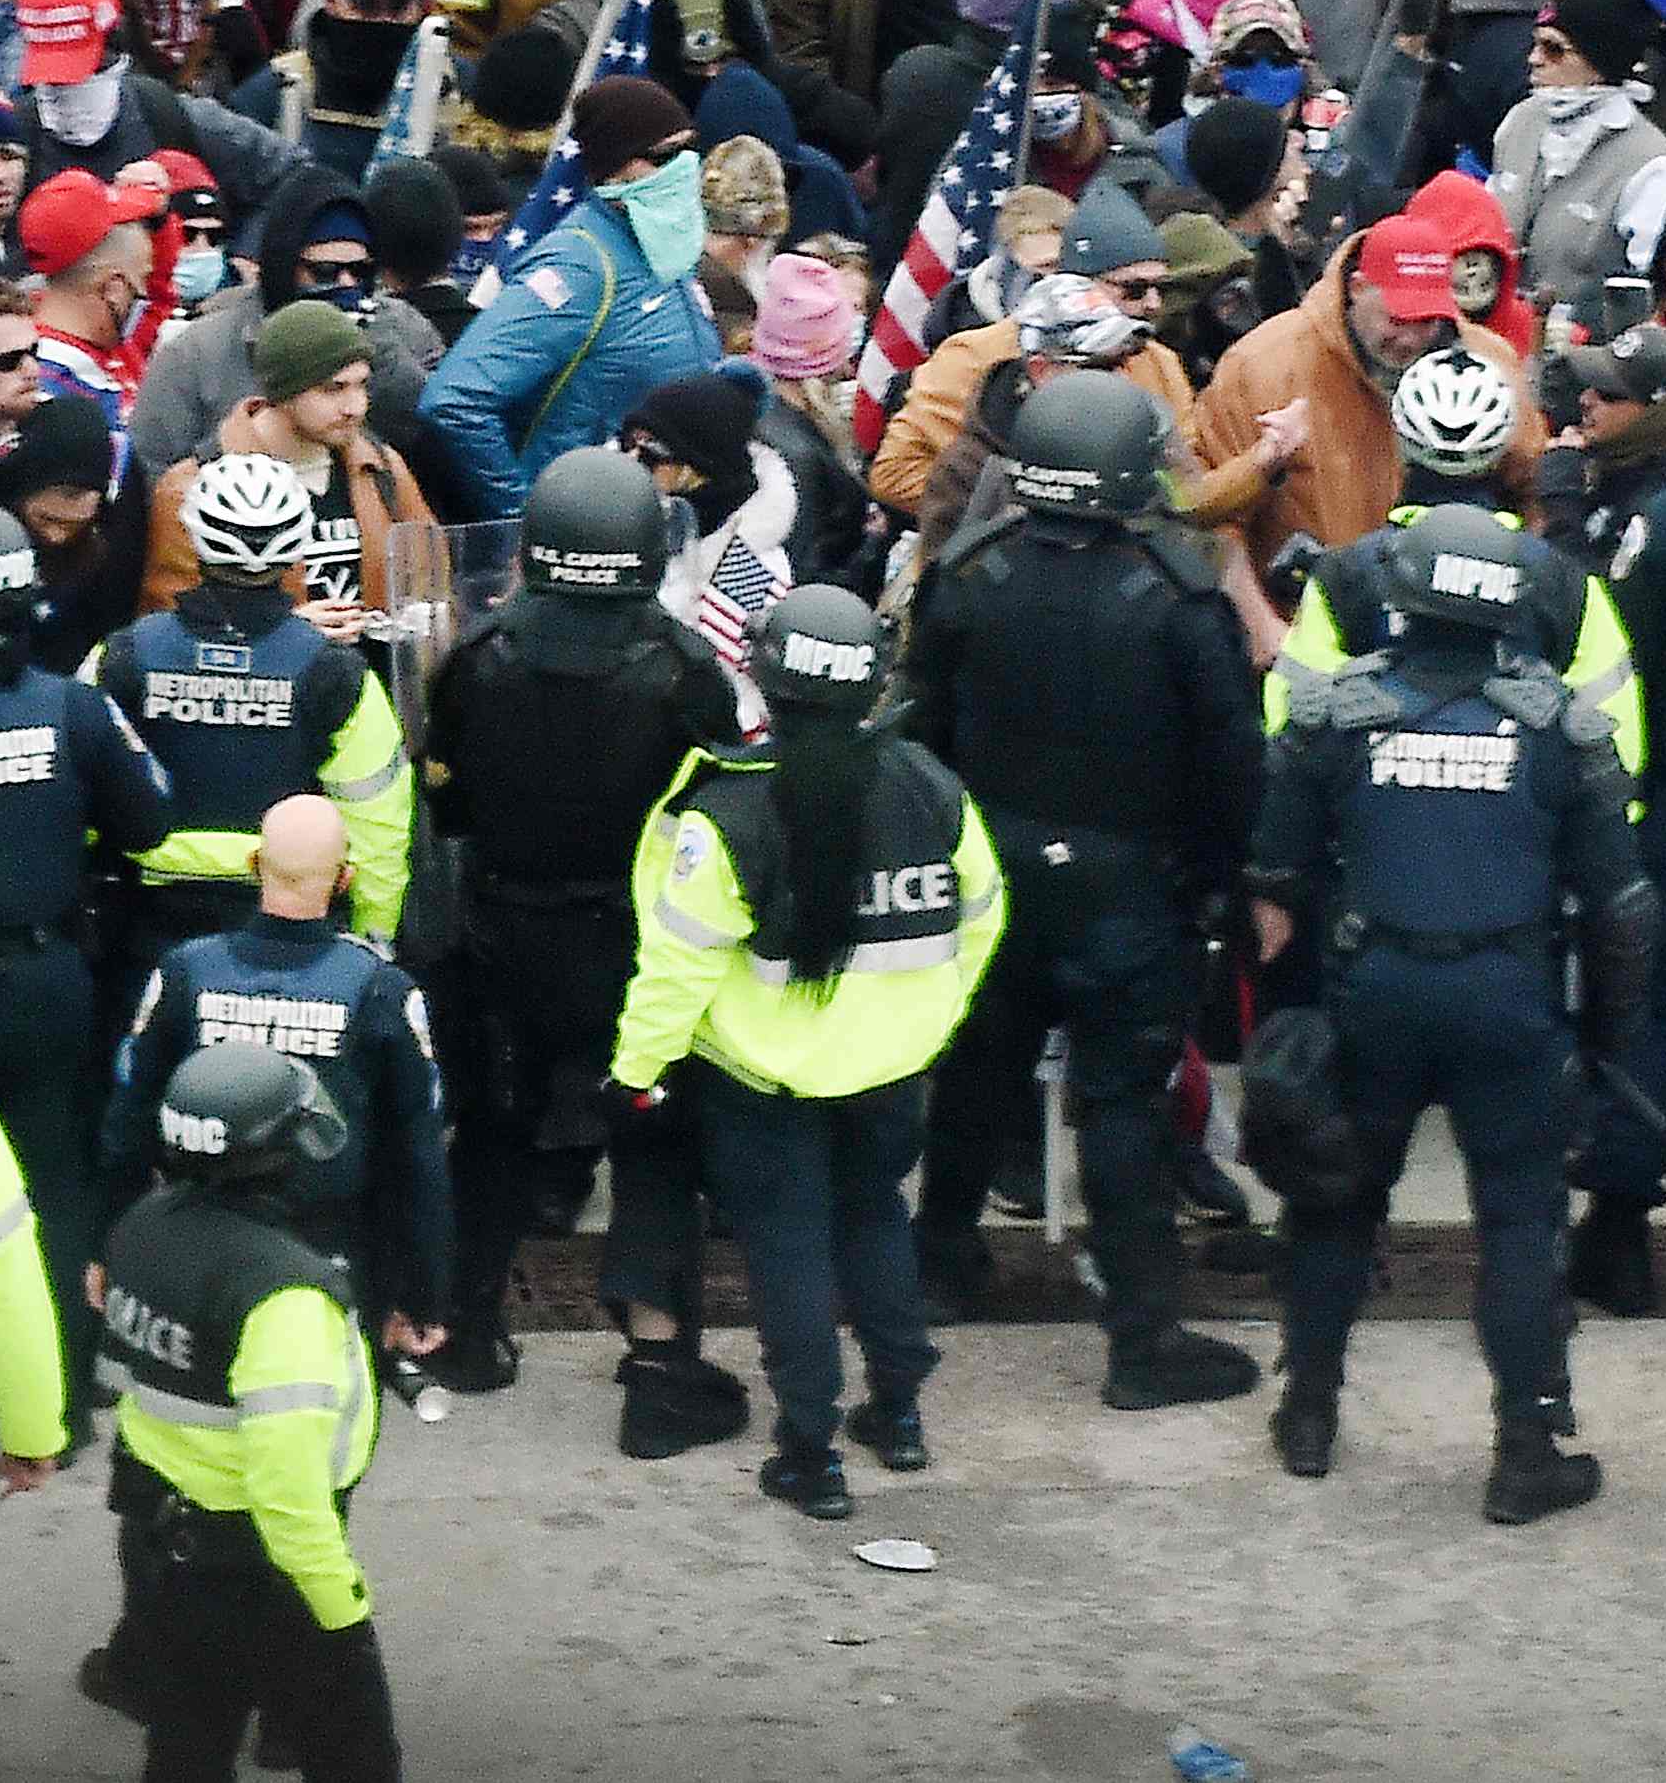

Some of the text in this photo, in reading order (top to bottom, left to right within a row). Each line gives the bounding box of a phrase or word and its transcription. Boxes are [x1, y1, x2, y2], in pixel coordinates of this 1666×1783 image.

[549, 568, 620, 585] POLICE
[144, 671, 294, 704] METROPOLITAN
[145, 697, 293, 728] POLICE
[857, 862, 955, 916] LICE
